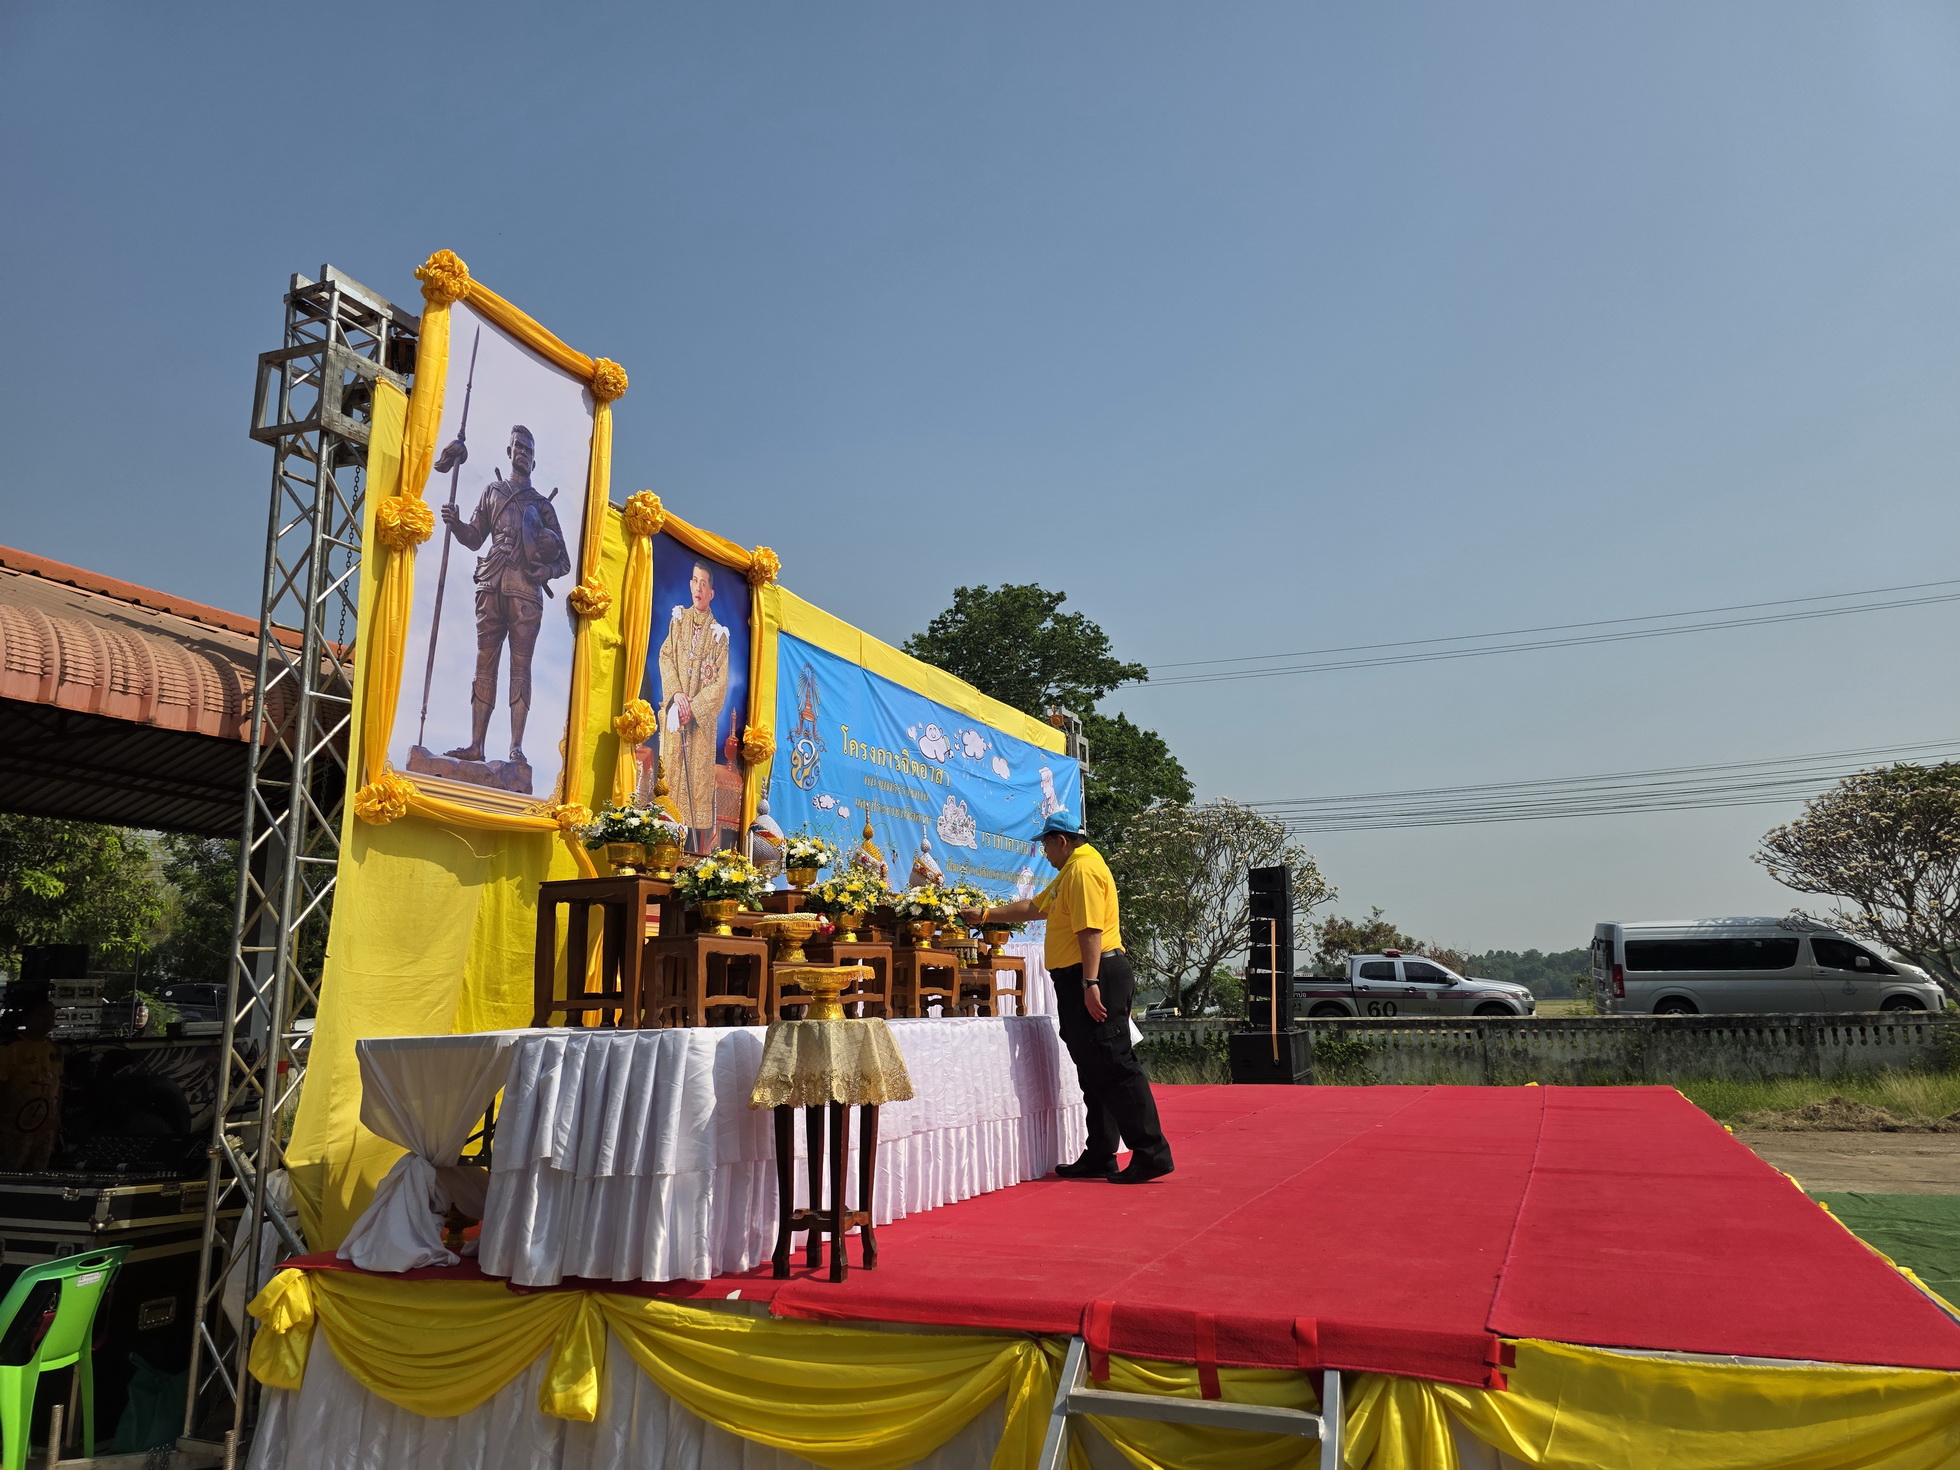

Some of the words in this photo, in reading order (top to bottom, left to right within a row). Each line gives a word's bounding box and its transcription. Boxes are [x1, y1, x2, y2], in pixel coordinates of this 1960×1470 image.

[840, 724, 951, 787] โครงการจิตอาสา
[1368, 1001, 1397, 1017] 60
